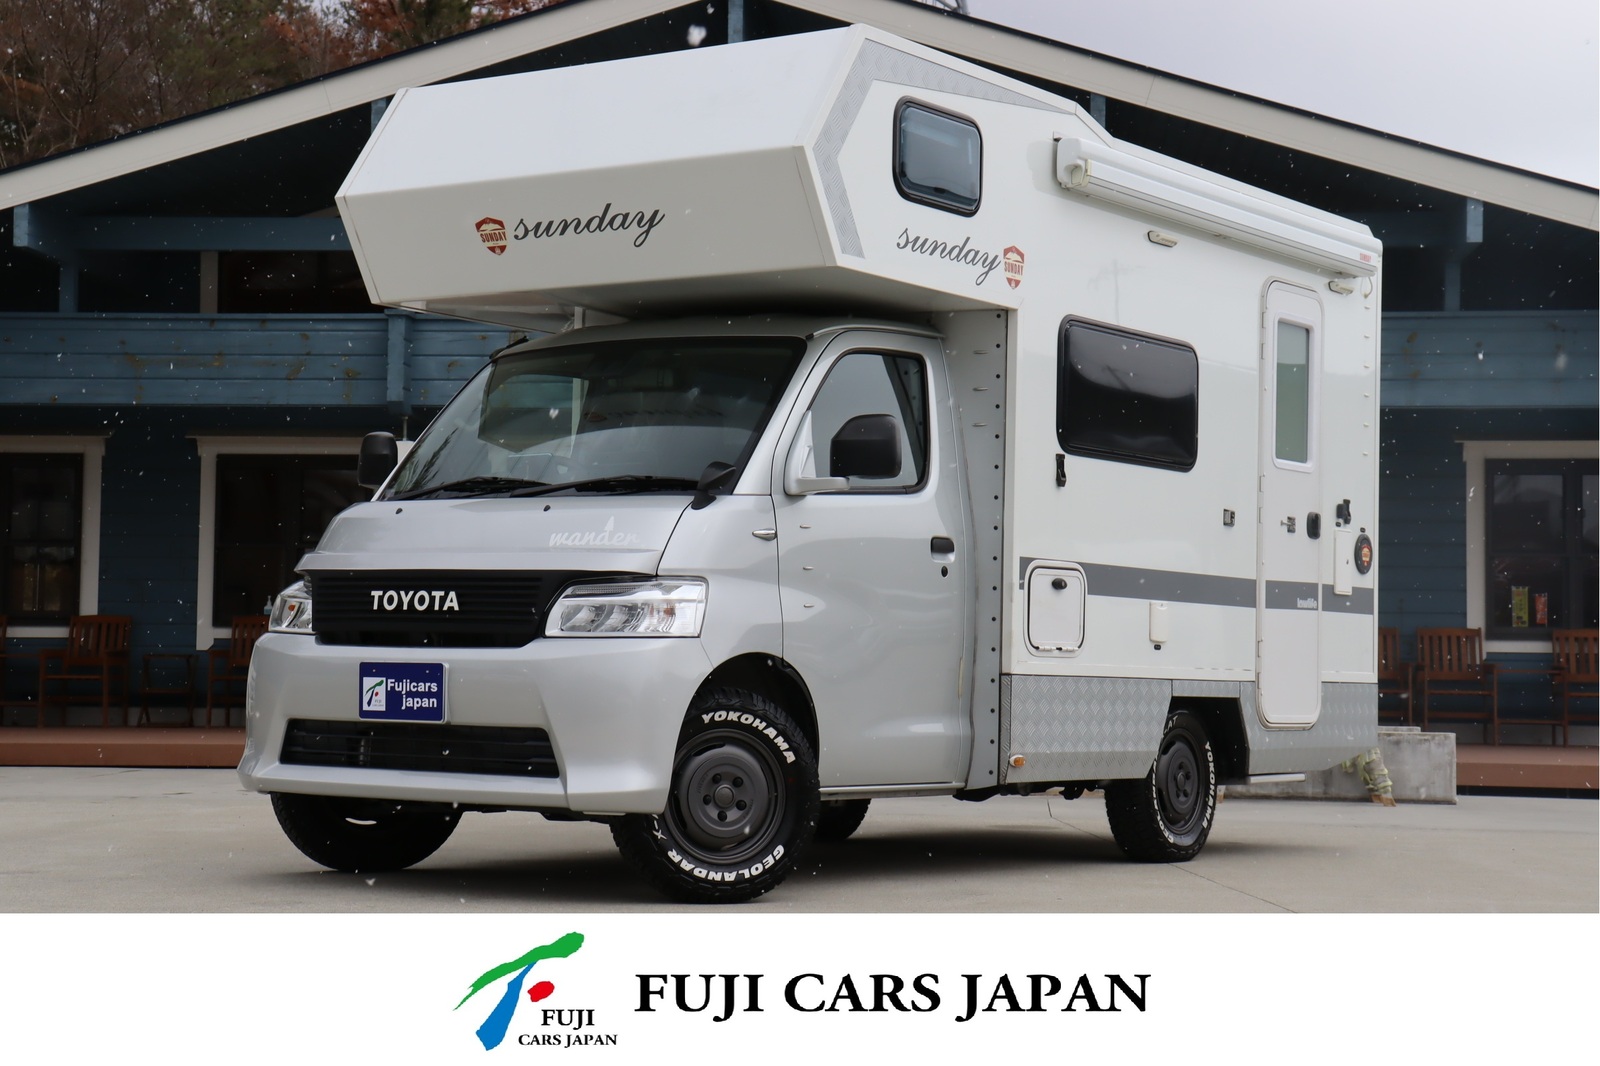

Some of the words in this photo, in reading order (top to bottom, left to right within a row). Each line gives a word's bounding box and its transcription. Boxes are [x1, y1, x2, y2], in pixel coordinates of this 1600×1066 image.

[480, 231, 507, 244] SUNDAY
[513, 202, 666, 248] sunday
[896, 227, 1002, 286] sunday
[1003, 260, 1024, 277] SUNDAY
[370, 589, 460, 611] TOYOTA
[387, 678, 438, 695] Fujicars
[401, 694, 437, 710] japan
[701, 710, 796, 764] YOKOHAMA
[1202, 741, 1216, 829] YOKOHAMA
[667, 844, 785, 882] GEOLANDAR
